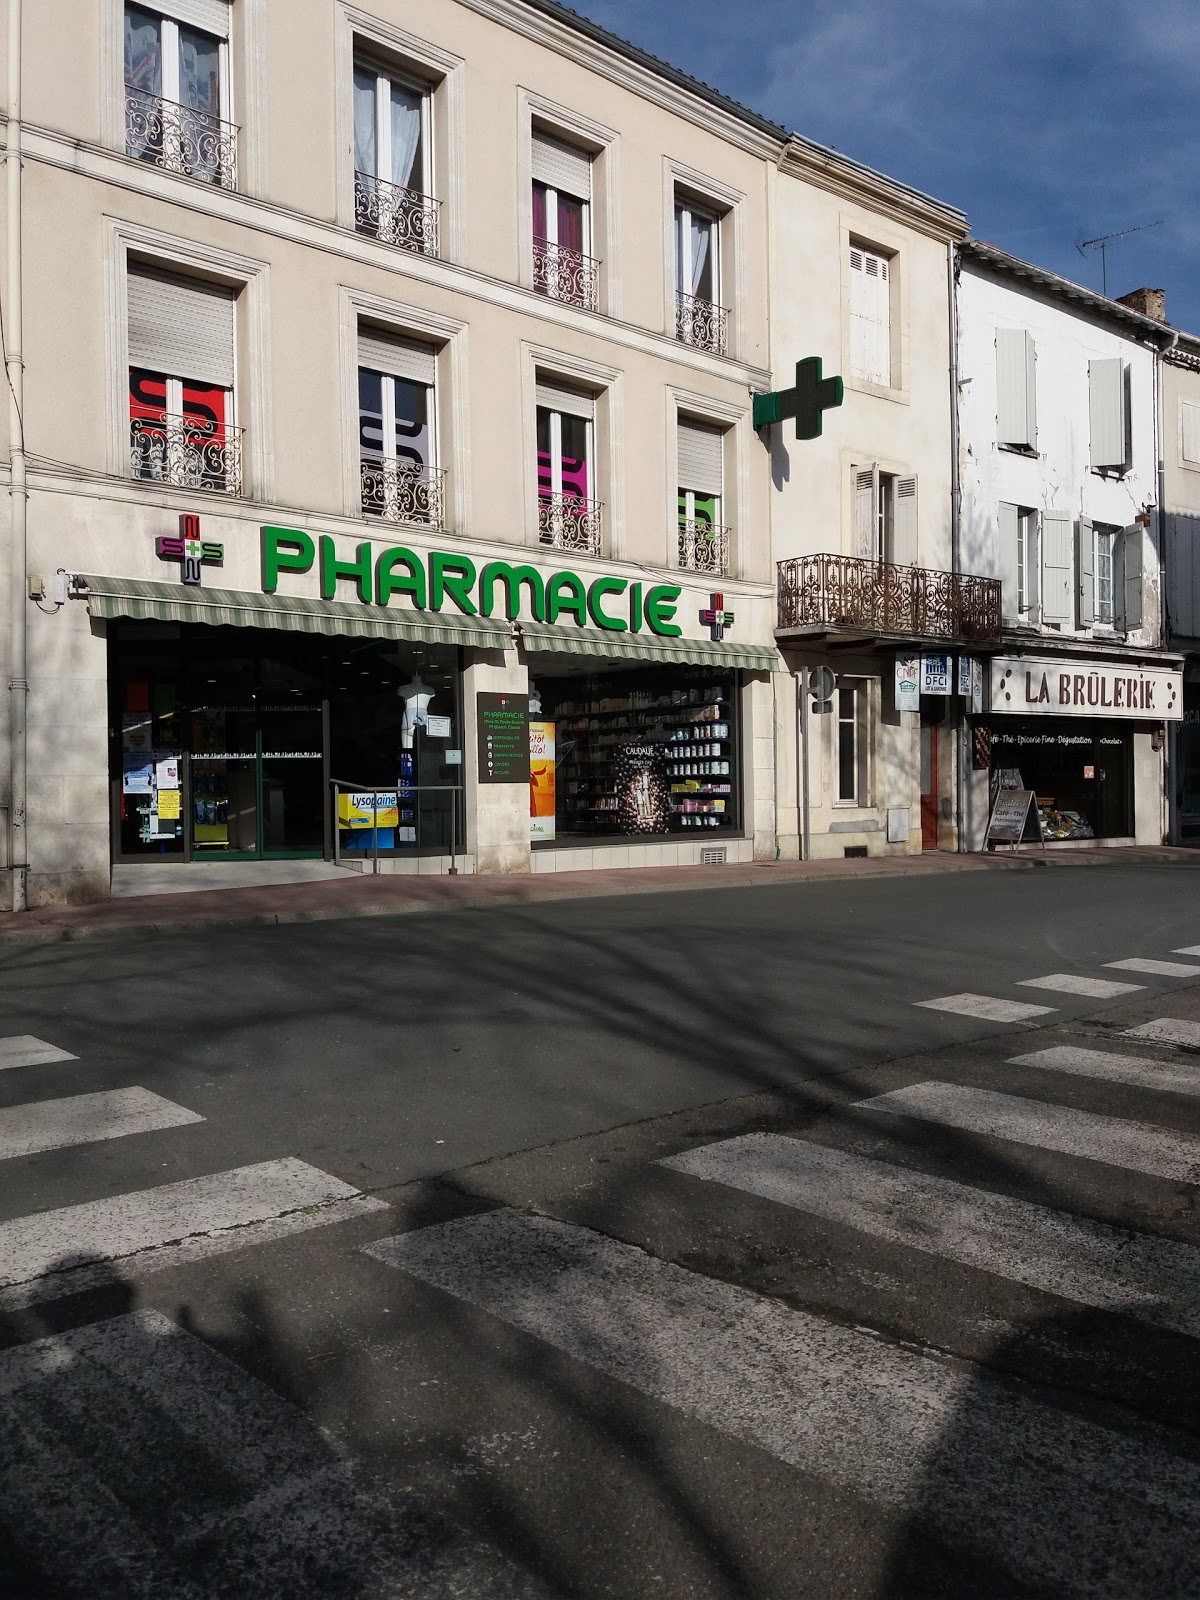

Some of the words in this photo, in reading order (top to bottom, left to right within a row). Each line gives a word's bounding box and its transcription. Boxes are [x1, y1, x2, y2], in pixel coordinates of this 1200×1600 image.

[261, 526, 683, 636] PHARMACIE
[896, 667, 918, 679] CNPF
[925, 676, 947, 686] DFCI
[1025, 671, 1050, 704] LA
[1041, 735, 1055, 744] Fine
[1058, 735, 1093, 746] Dégustation
[352, 794, 396, 809] Lysopaïne
